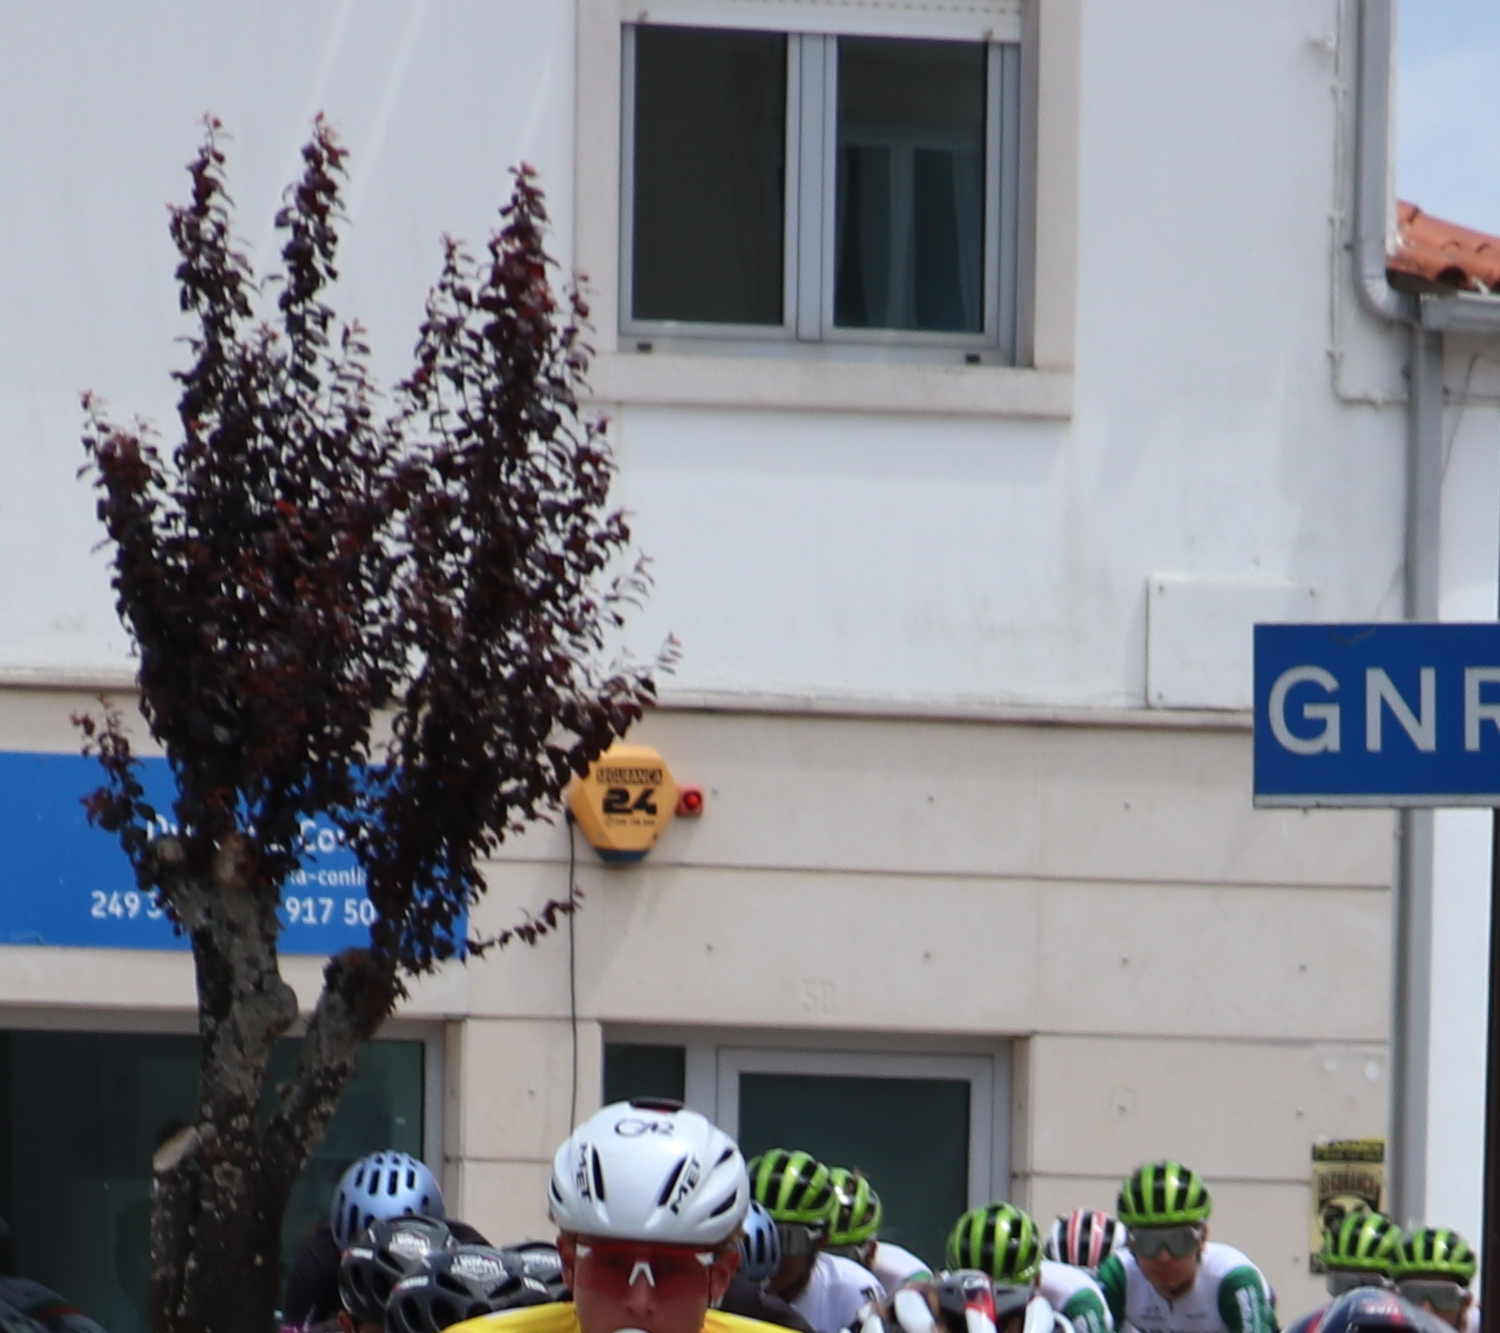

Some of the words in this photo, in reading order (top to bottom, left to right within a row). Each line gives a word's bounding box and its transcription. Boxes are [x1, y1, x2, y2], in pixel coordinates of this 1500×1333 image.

[603, 787, 657, 815] 24
[91, 891, 140, 918] 249
[286, 897, 332, 925] 917
[344, 900, 376, 926] 50
[671, 1158, 701, 1215] MET
